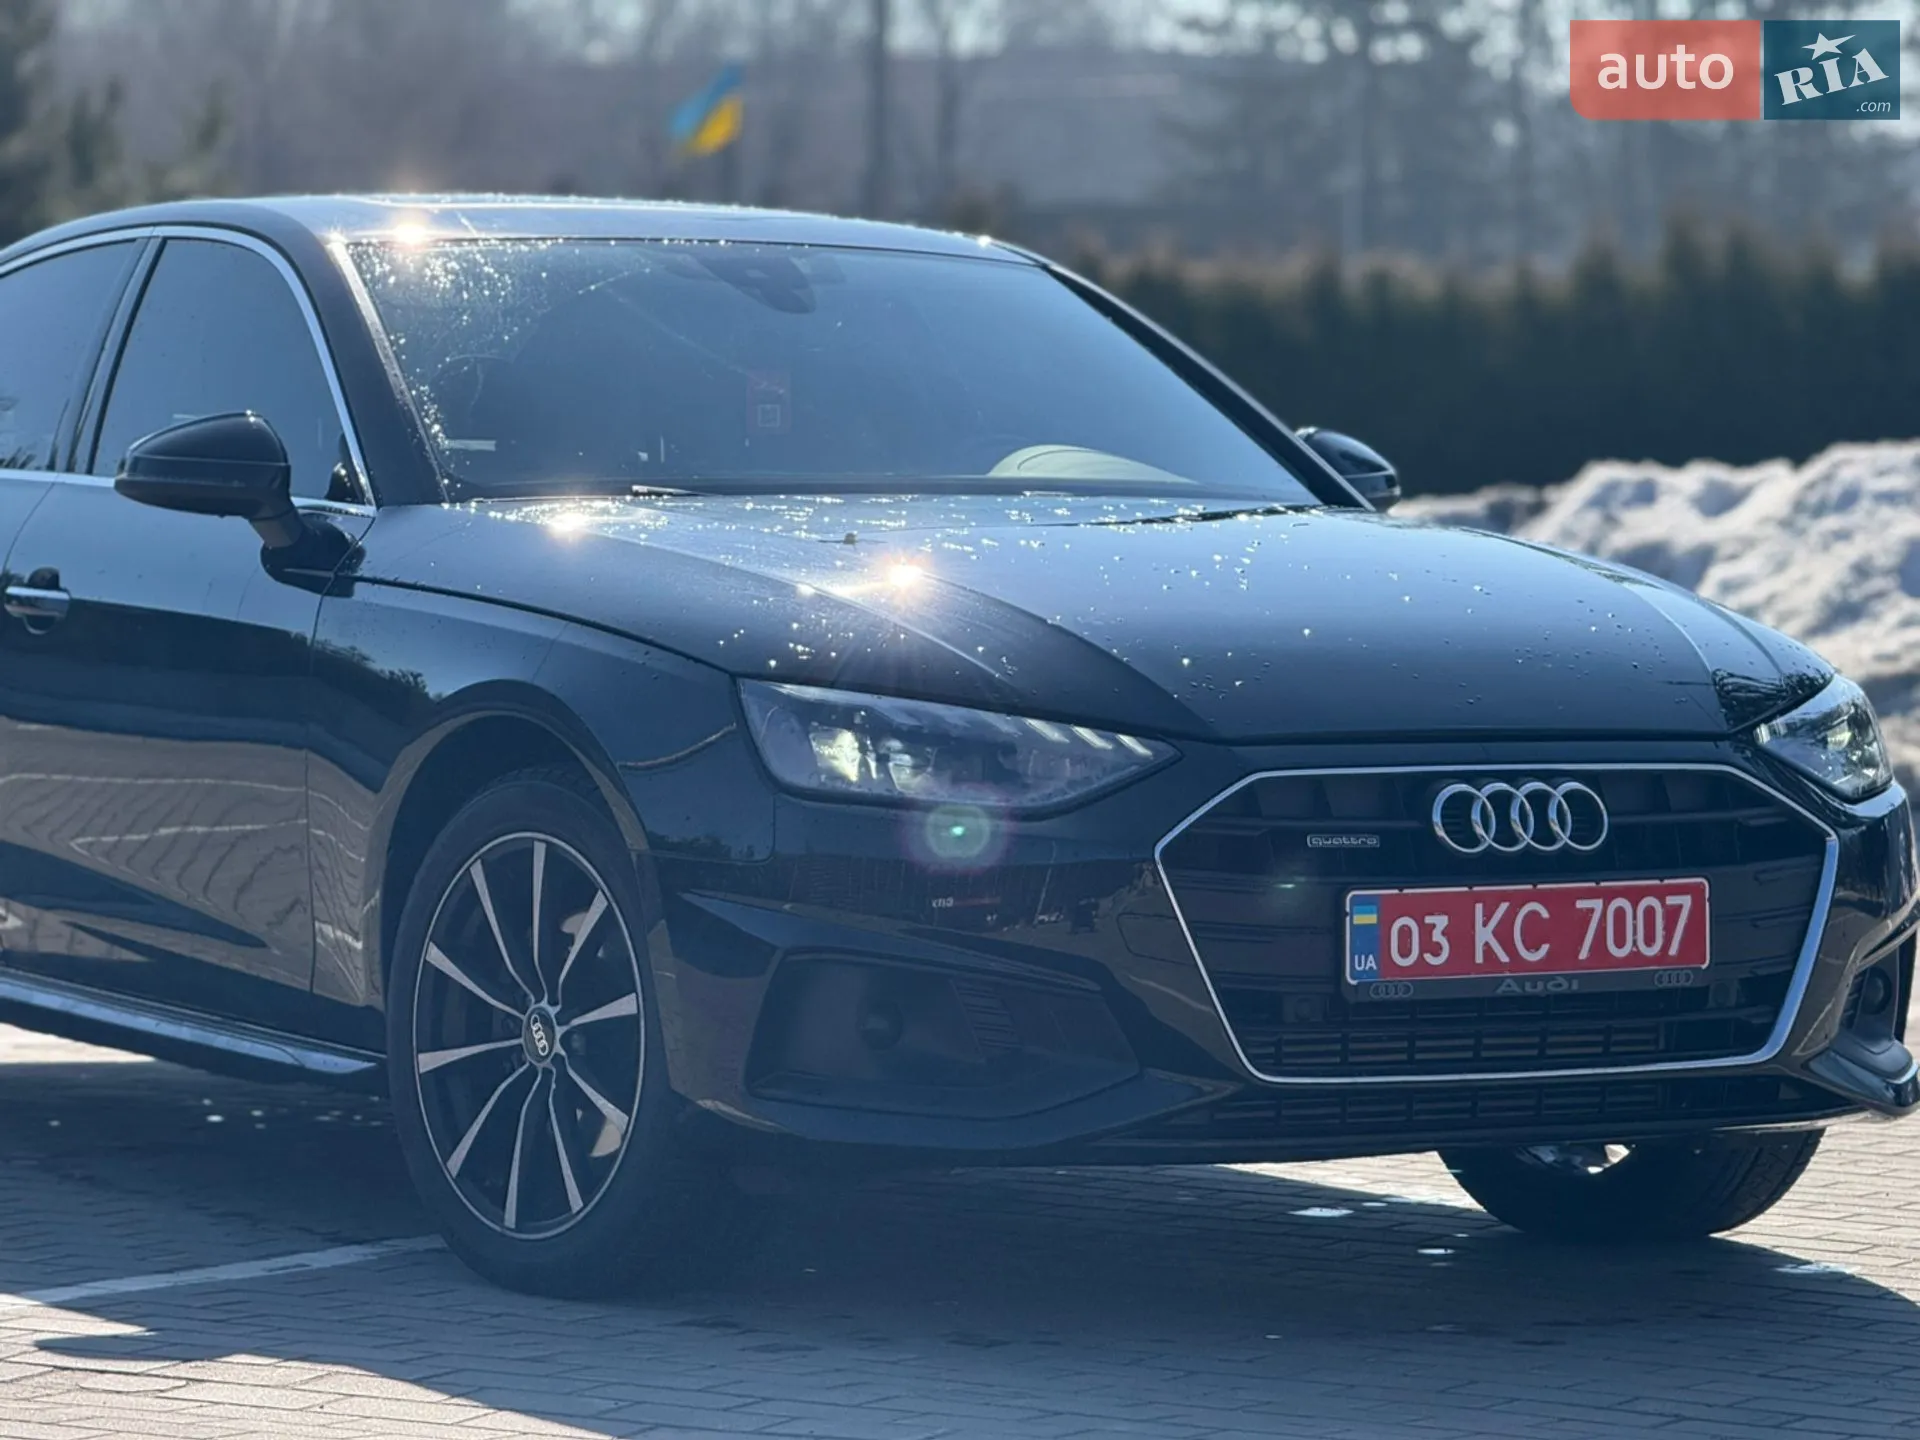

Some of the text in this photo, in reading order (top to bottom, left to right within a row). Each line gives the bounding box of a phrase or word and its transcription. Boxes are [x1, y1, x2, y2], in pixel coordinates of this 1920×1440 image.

[1310, 835, 1379, 847] quattro
[1390, 895, 1692, 967] 03 KC 7007
[1354, 954, 1378, 971] UA
[1494, 977, 1580, 996] Audi
